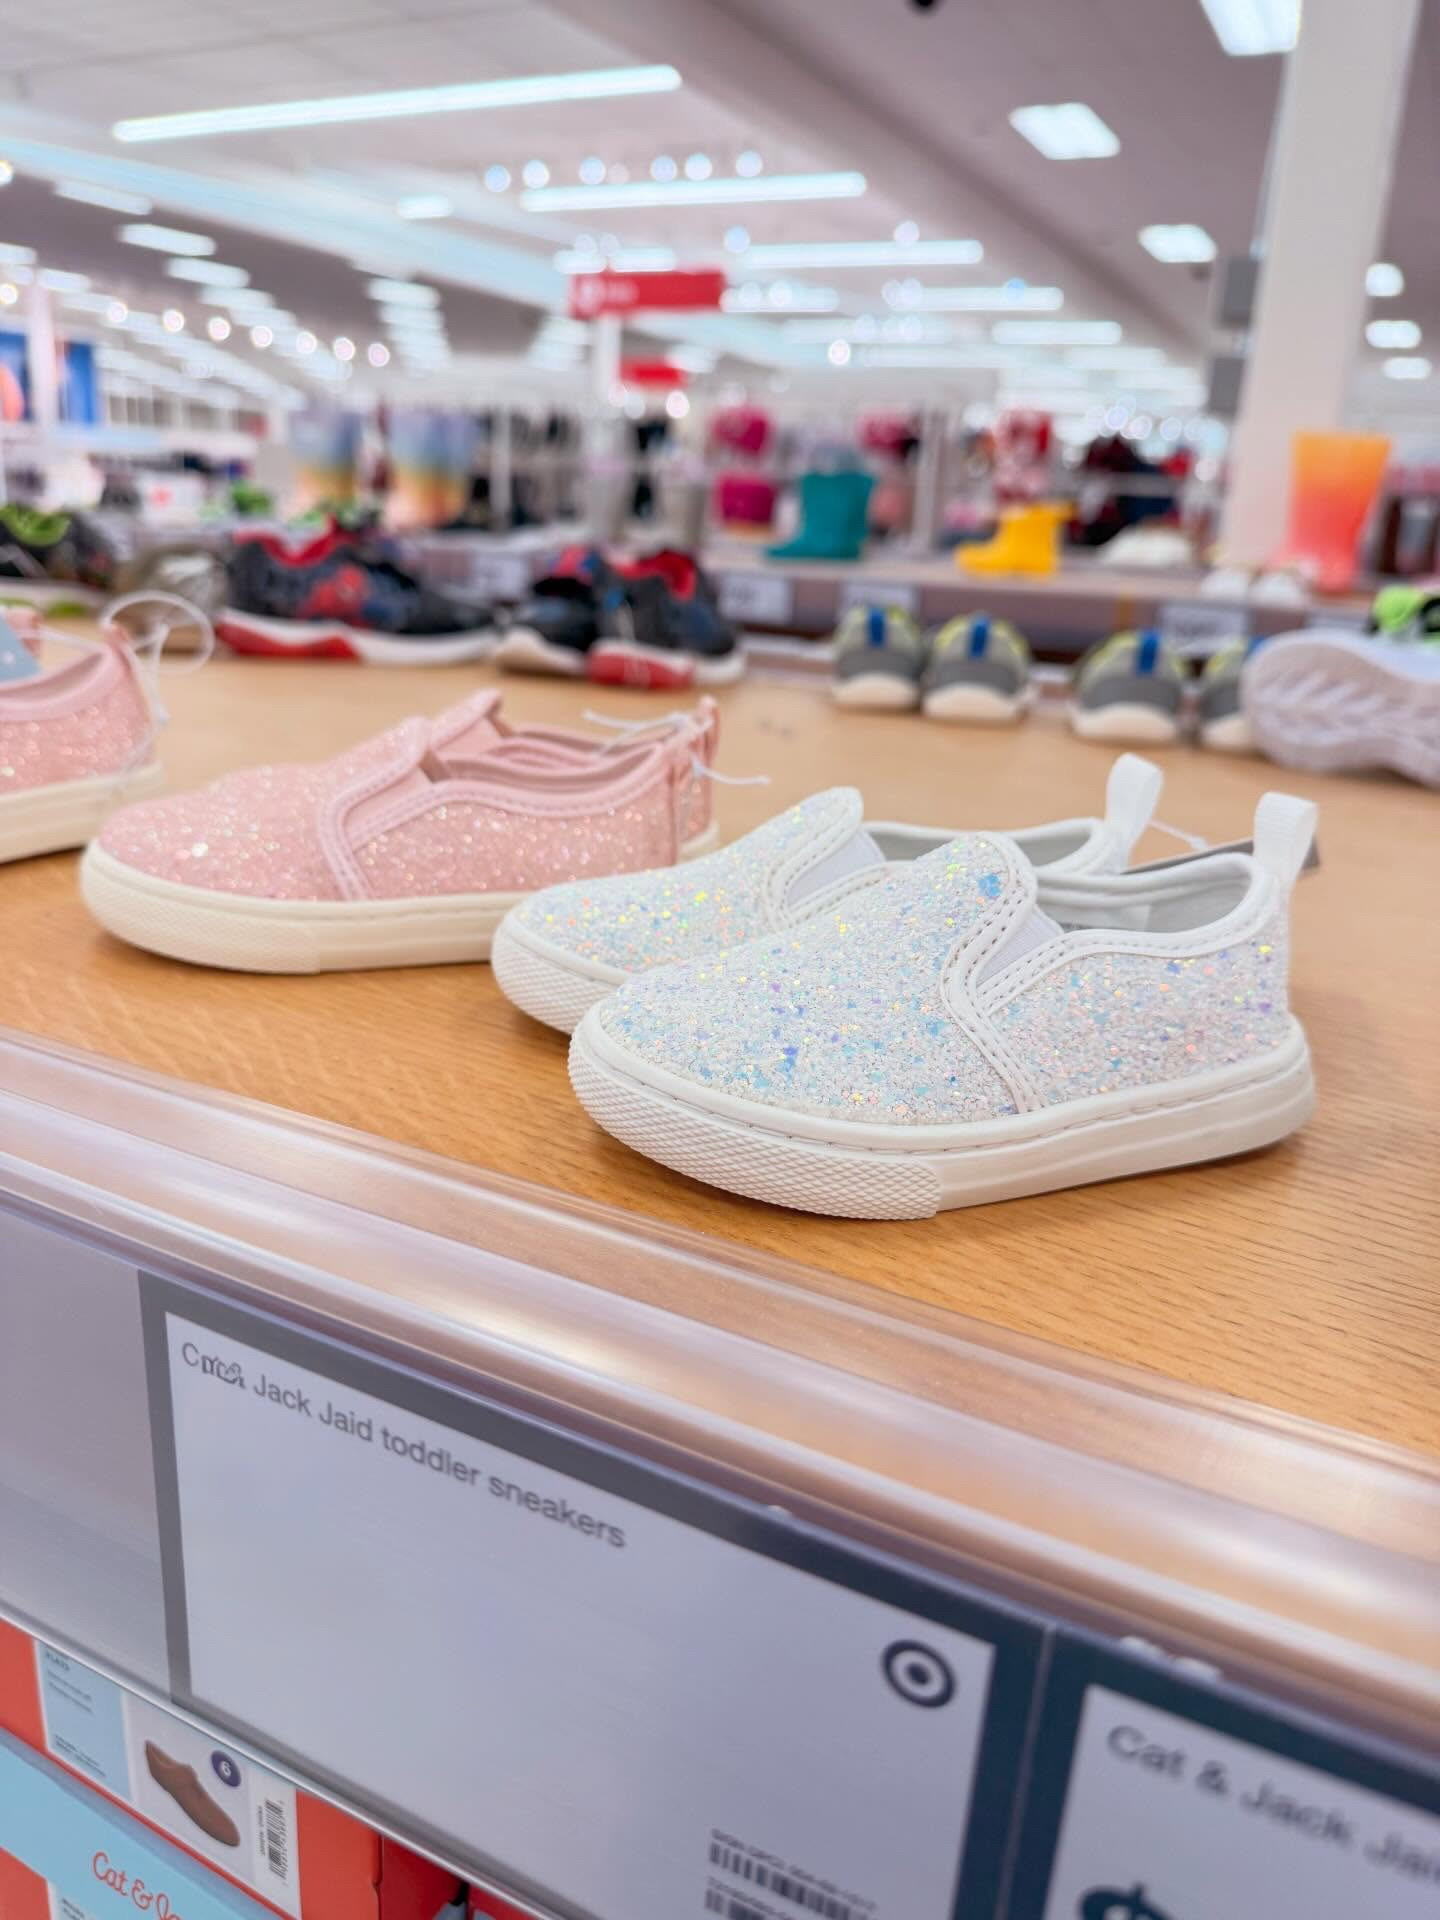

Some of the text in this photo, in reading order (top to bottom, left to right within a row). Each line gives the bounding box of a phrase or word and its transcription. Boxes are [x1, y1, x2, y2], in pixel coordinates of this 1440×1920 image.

[253, 1373, 626, 1549] Jack Jaid toddler sneakers
[1106, 1724, 1184, 1780] Cat
[1196, 1759, 1230, 1797] &
[1240, 1780, 1352, 1846] Jack
[93, 1851, 128, 1897] Cat
